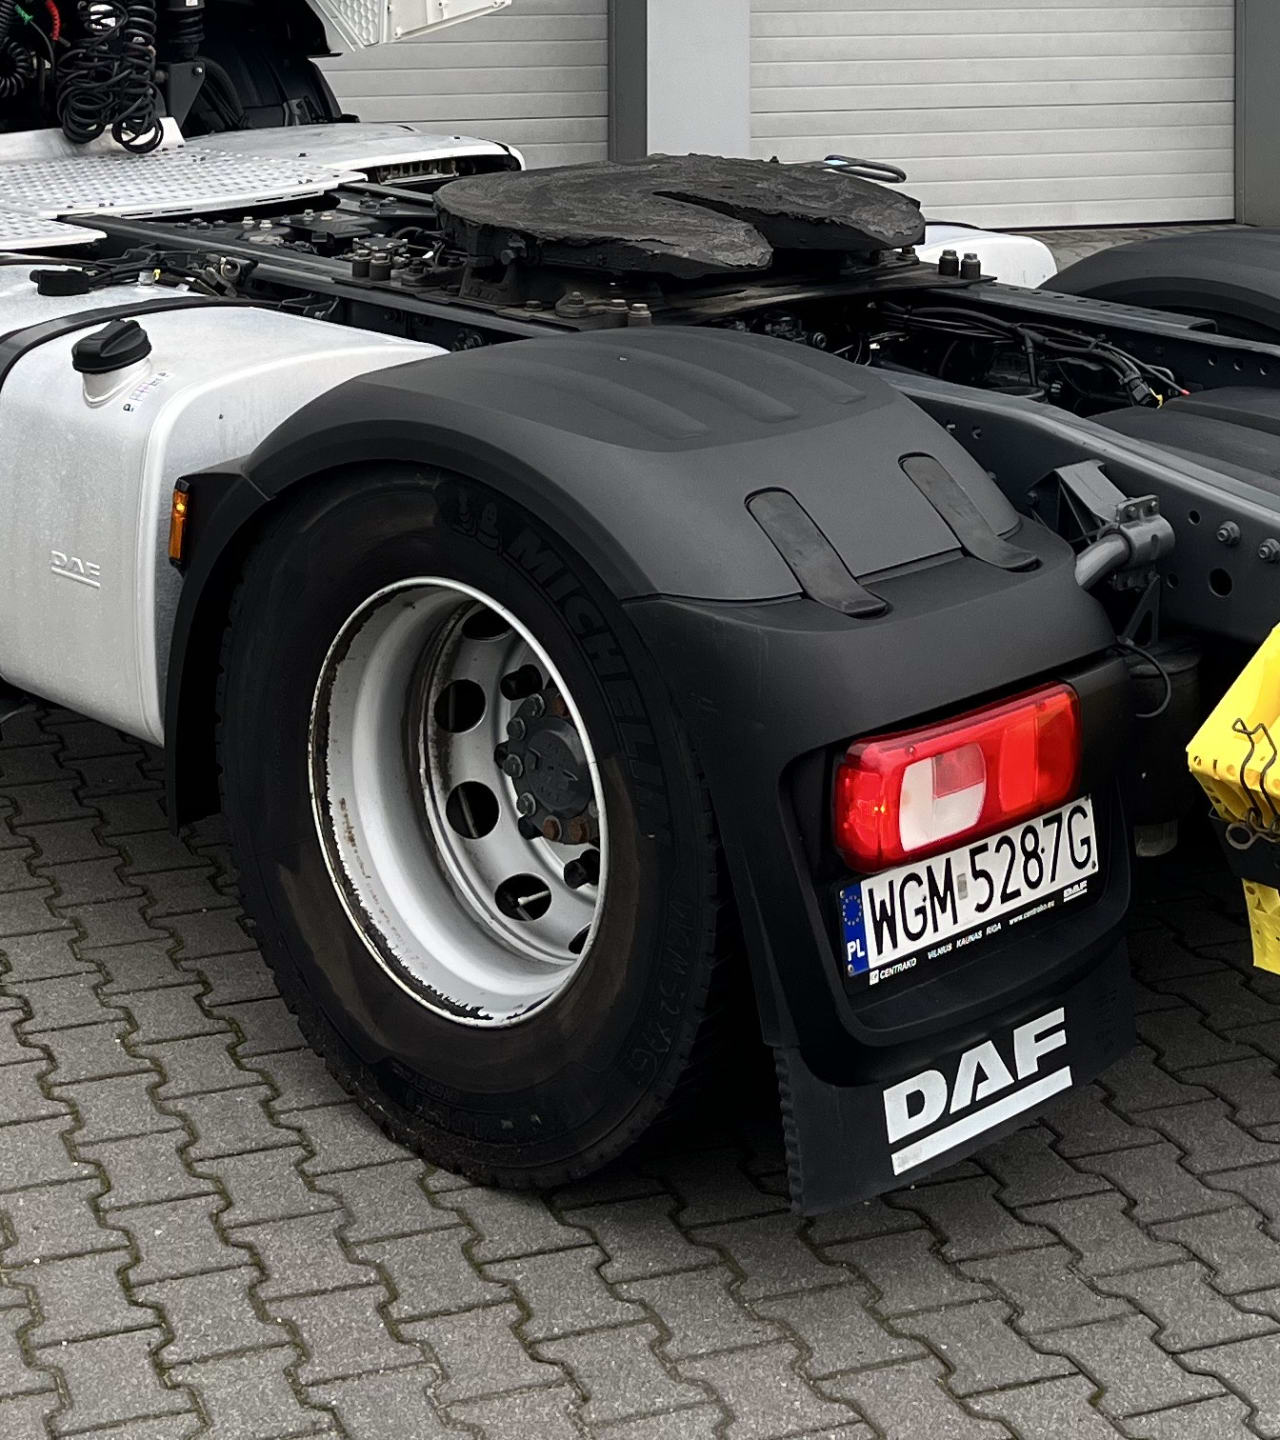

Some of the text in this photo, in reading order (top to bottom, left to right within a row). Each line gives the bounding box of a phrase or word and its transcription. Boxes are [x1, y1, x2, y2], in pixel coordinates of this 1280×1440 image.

[51, 550, 100, 576] DAF
[867, 806, 1092, 956] WGM 5287G
[880, 958, 917, 979] CENTRAKO
[927, 943, 953, 960] VILNIUS
[956, 931, 983, 948] KAUNAS
[986, 923, 1002, 936] RIGA
[1063, 880, 1089, 898] DAF
[847, 939, 865, 960] PL
[883, 1007, 1066, 1144] DAF
